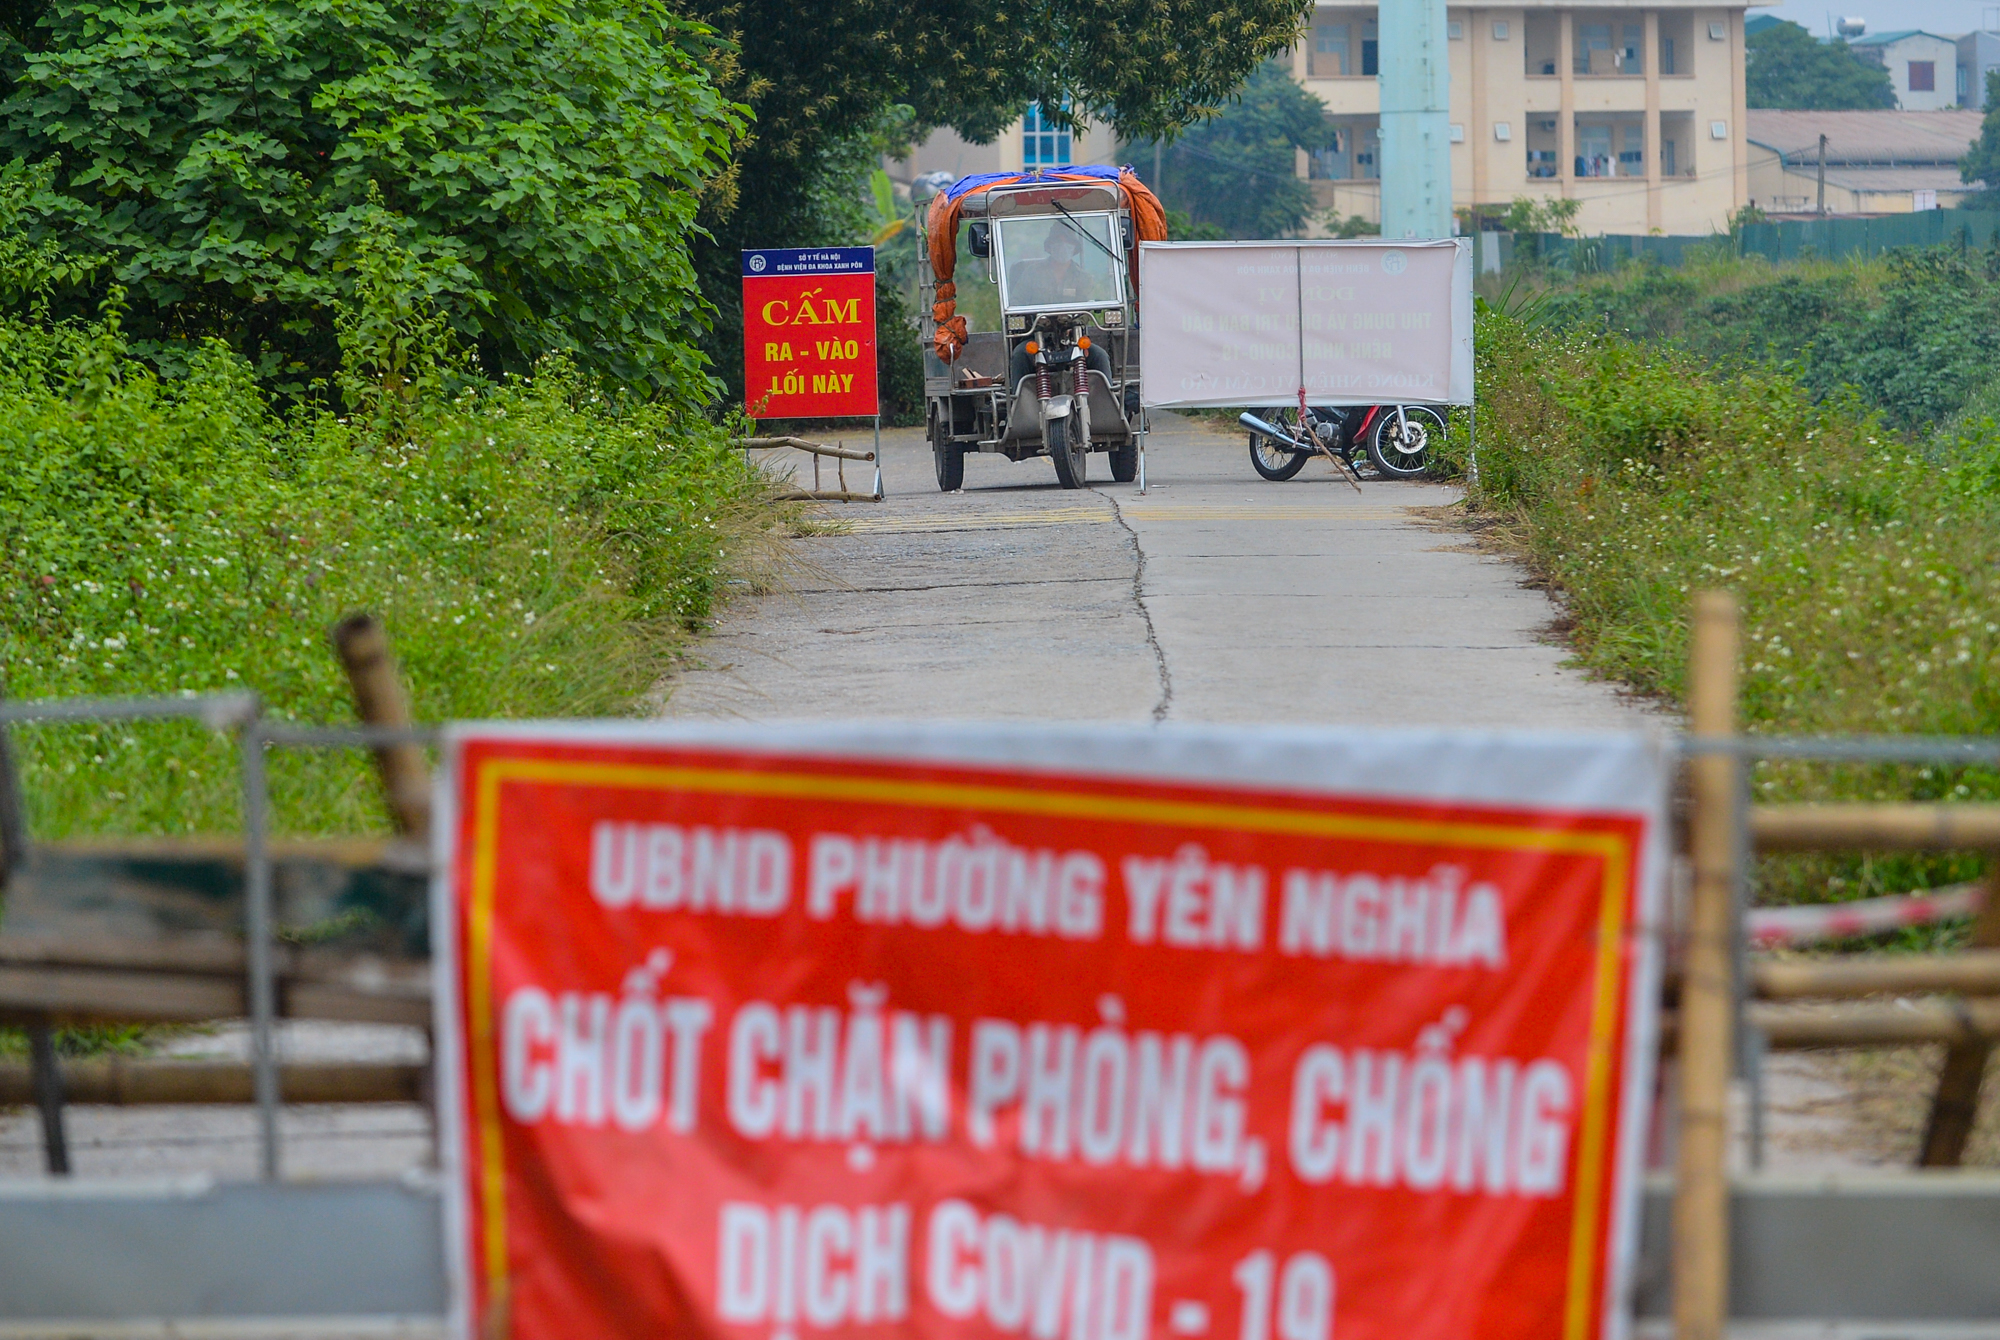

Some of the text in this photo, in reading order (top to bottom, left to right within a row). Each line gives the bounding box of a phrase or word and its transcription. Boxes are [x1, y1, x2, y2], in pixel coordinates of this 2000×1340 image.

[777, 263, 793, 272] BỆNH
[793, 262, 807, 271] VIỆN
[850, 261, 863, 269] PÔN
[812, 252, 820, 261] TẾ
[830, 252, 841, 261] NỘI
[762, 287, 862, 326] CẤM
[765, 342, 793, 362] RA
[816, 336, 859, 360] VÀO
[771, 368, 854, 395] LỐI NÀY
[590, 820, 1508, 970] UBND PHƯỜNG YÊN NGHĨA
[503, 947, 1573, 1197] CHỐT CHẶN PHÒNG, CHỐNG
[716, 1199, 1337, 1340] DỊCH COVID - 19
